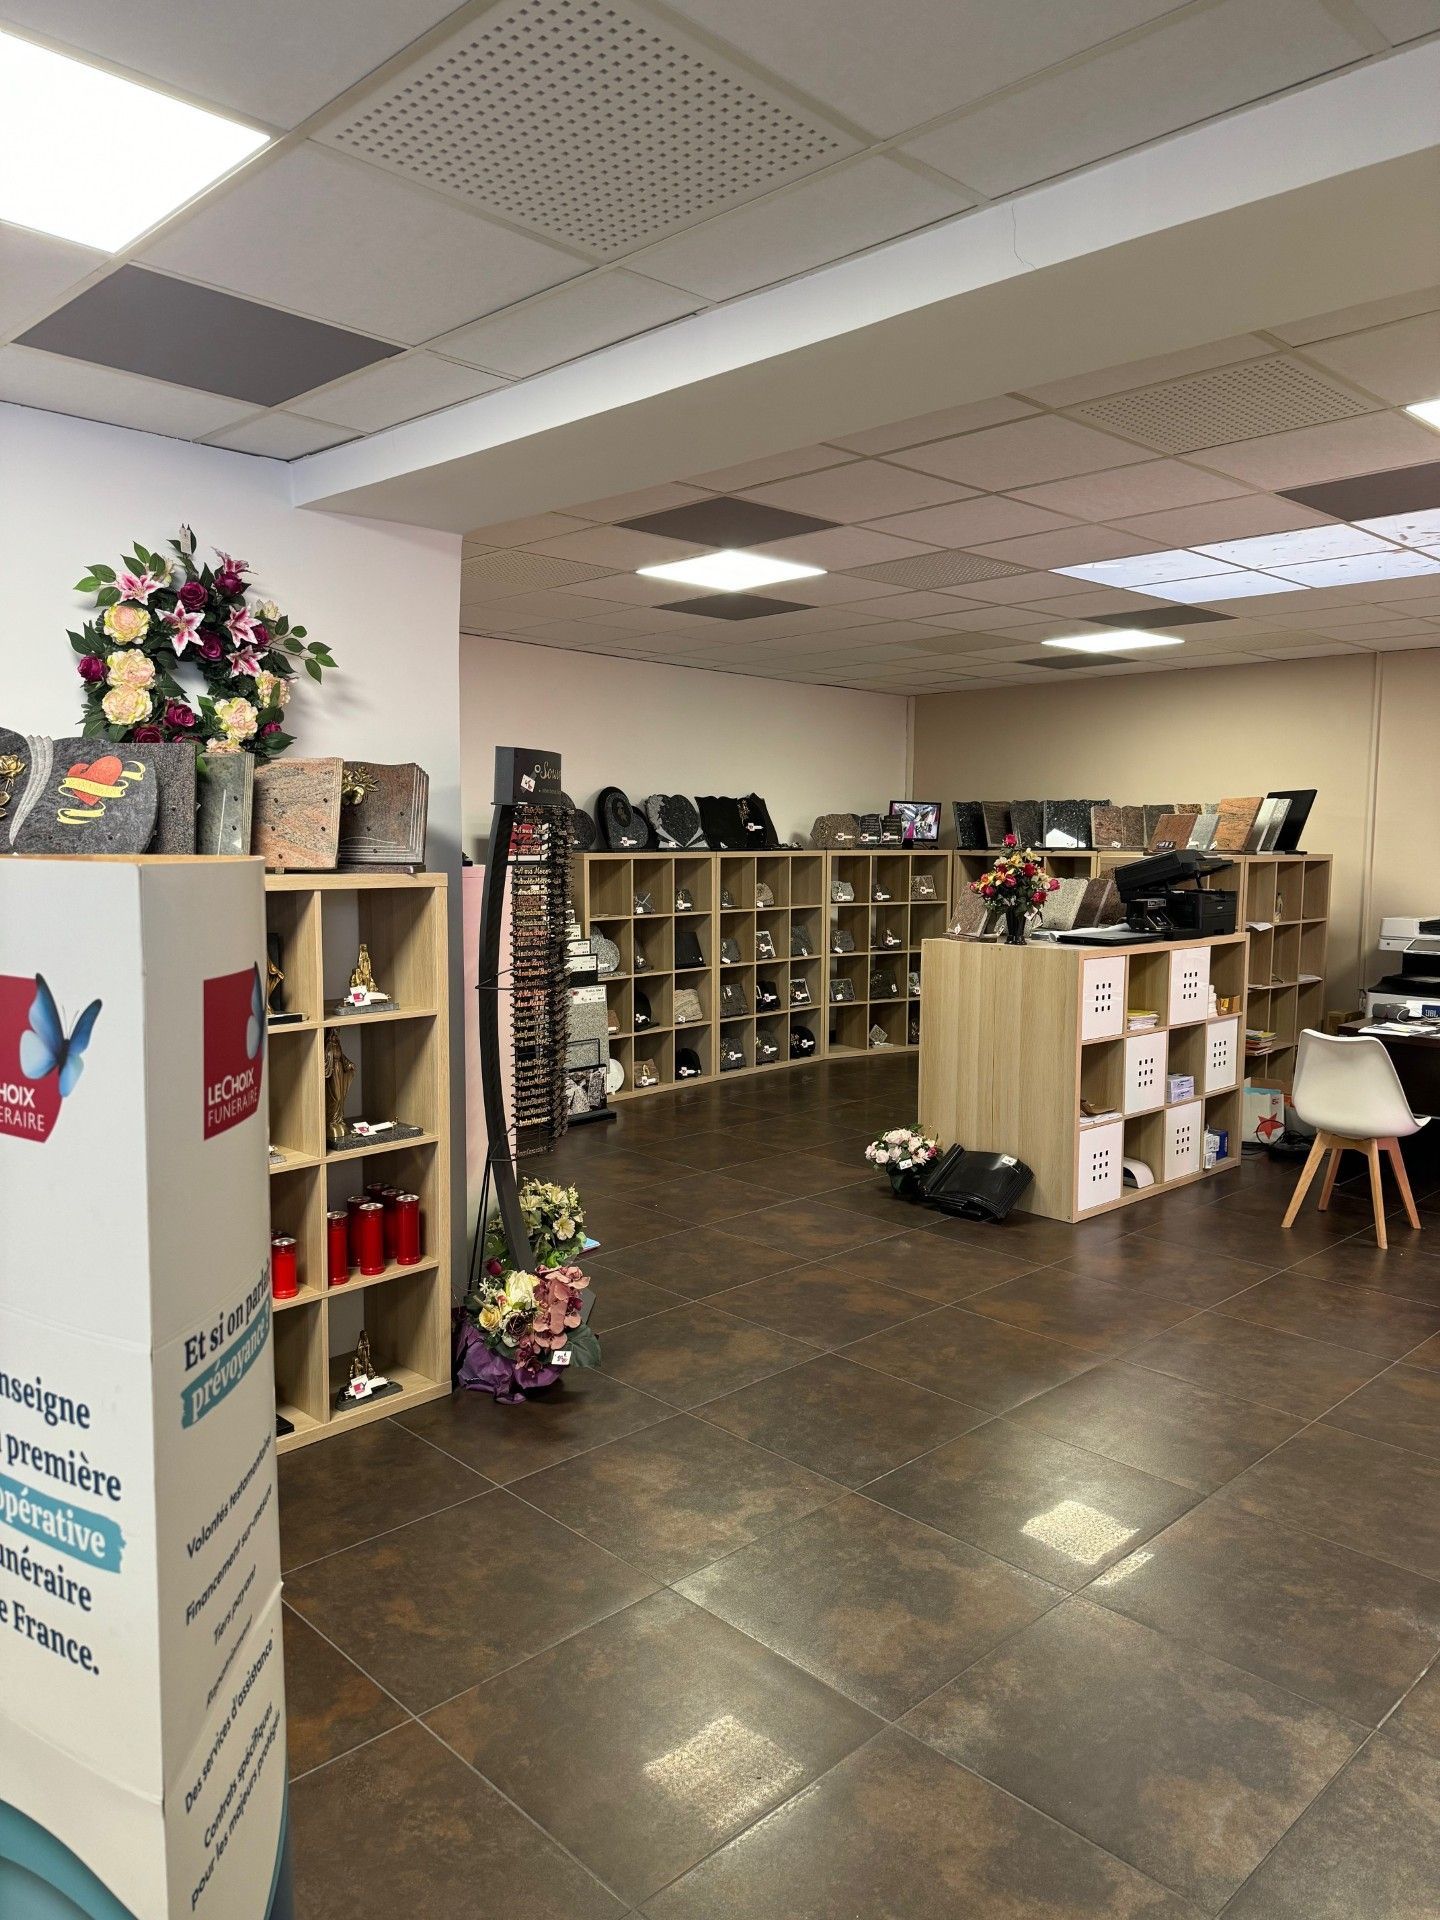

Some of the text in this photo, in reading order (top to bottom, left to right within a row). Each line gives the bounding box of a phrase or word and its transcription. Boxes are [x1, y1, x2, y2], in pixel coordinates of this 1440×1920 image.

[185, 1331, 206, 1372] Et
[210, 1311, 224, 1352] si
[227, 1303, 244, 1337] on
[192, 1317, 265, 1422] prévoyance
[5, 1433, 122, 1502] première
[187, 1502, 229, 1559] Volontés
[186, 1538, 241, 1626] Financement
[12, 1600, 100, 1676] France.
[185, 1776, 203, 1815] Des
[202, 1717, 232, 1781] services
[192, 1856, 215, 1912] pour
[215, 1831, 229, 1861] les
[229, 1771, 258, 1836] majeurs
[204, 1780, 238, 1848] Contrats
